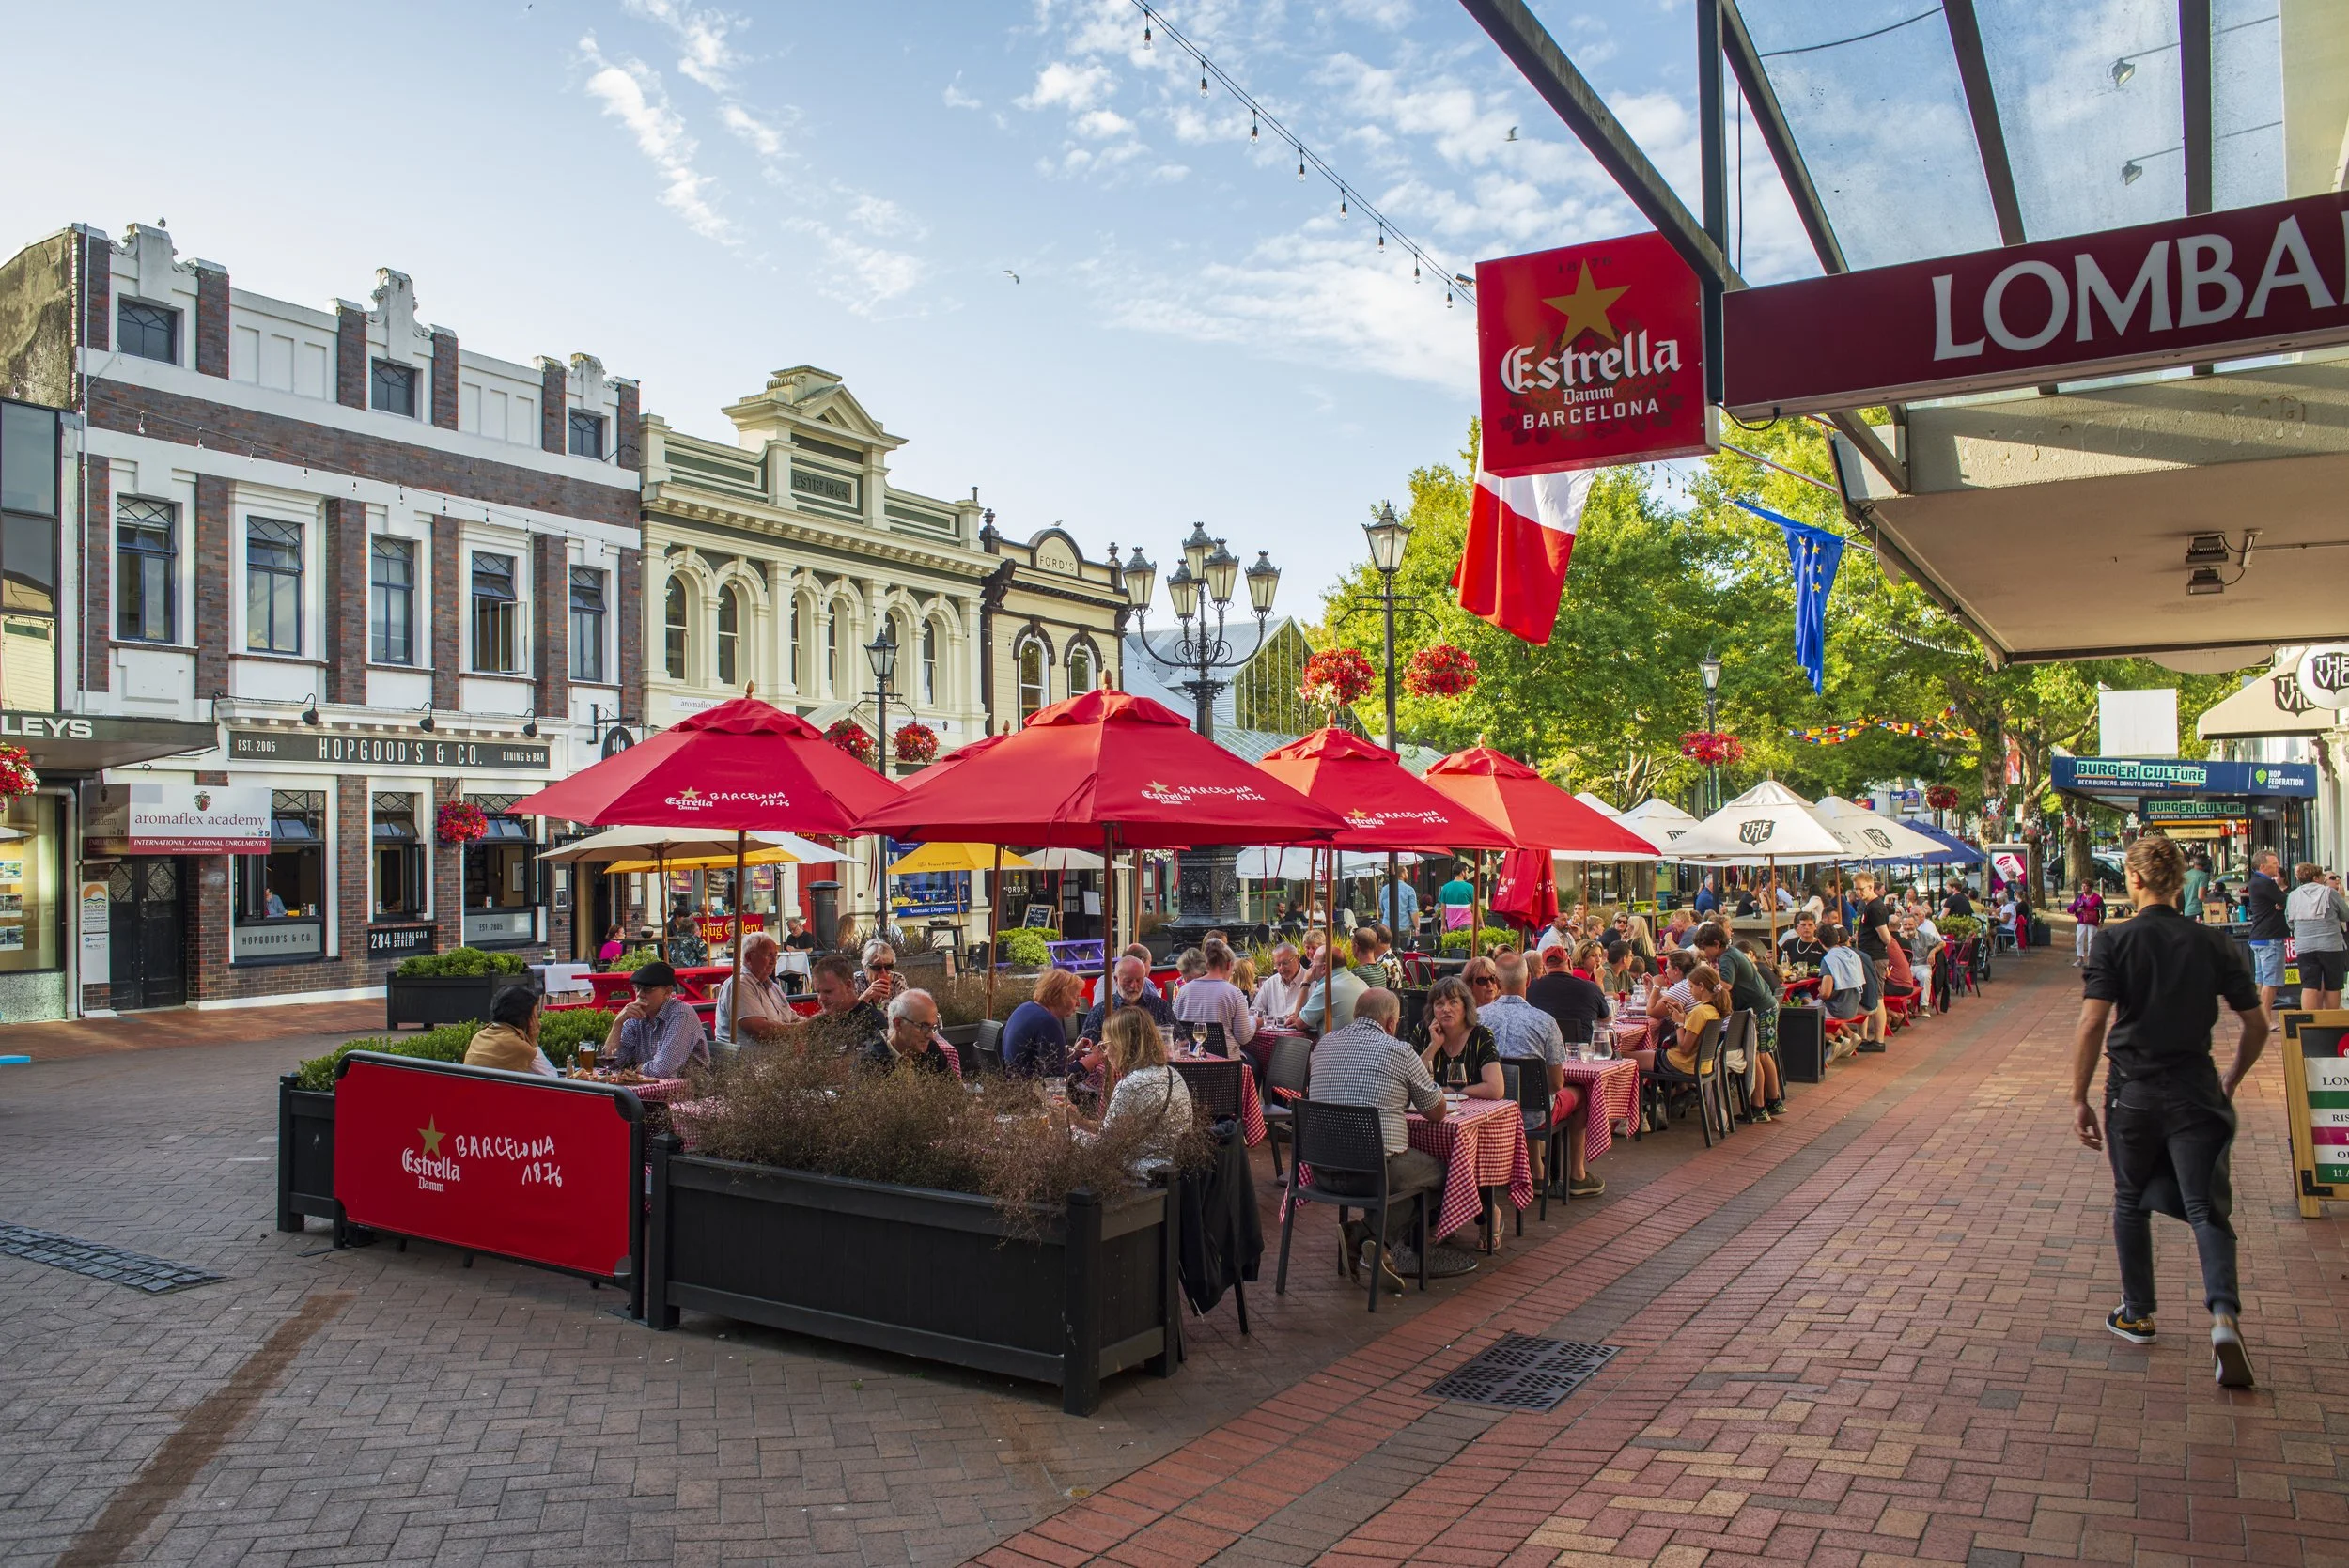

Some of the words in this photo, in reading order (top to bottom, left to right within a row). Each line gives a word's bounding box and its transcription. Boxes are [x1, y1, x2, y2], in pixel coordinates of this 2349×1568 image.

[1933, 210, 2349, 362] LOMBA
[1500, 328, 1683, 395] Estrella
[1562, 386, 1615, 405] Damm
[1522, 397, 1660, 430] BARCELONA
[826, 481, 848, 499] 1864
[1039, 555, 1074, 572] FORD'S
[2316, 656, 2349, 672] THE
[2278, 676, 2298, 692] TH
[2316, 670, 2349, 687] VIC
[1, 715, 93, 739] LEYS
[238, 739, 254, 752] EST.
[256, 740, 276, 753] 2005
[319, 737, 424, 763] HOPGOOD'S
[436, 743, 445, 764] &
[457, 745, 483, 765] CO.
[503, 751, 524, 762] DINING
[526, 752, 531, 762] &
[532, 753, 545, 763] BAR
[2077, 762, 2137, 778] BURGER
[2143, 766, 2205, 781] CULTURE
[2268, 769, 2281, 778] HOP
[2267, 778, 2304, 786] FEDERATION
[665, 797, 713, 807] Estrella
[709, 791, 786, 800] BARCELONA
[1141, 790, 1192, 801] Estrella
[1178, 785, 1252, 795] BARCELONA
[1237, 793, 1266, 801] 1876
[1375, 810, 1439, 819] BARCELONA
[2149, 802, 2195, 813] BURGER
[2199, 803, 2246, 814] CULTURE
[134, 812, 204, 826] aromaflex
[207, 813, 266, 830] academy
[1343, 816, 1385, 826] Estrella
[1745, 822, 1771, 832] THE
[1743, 831, 1767, 842] VIC
[930, 906, 955, 914] Dispensary
[241, 934, 288, 945] HOPGOOD'S
[371, 932, 391, 949] 284
[394, 930, 428, 939] TRAFALGAR
[394, 939, 415, 948] STREET
[455, 1134, 555, 1161] BARCELONA
[401, 1147, 461, 1182] Estrella
[418, 1176, 444, 1193] Damm
[521, 1162, 563, 1188] 1876
